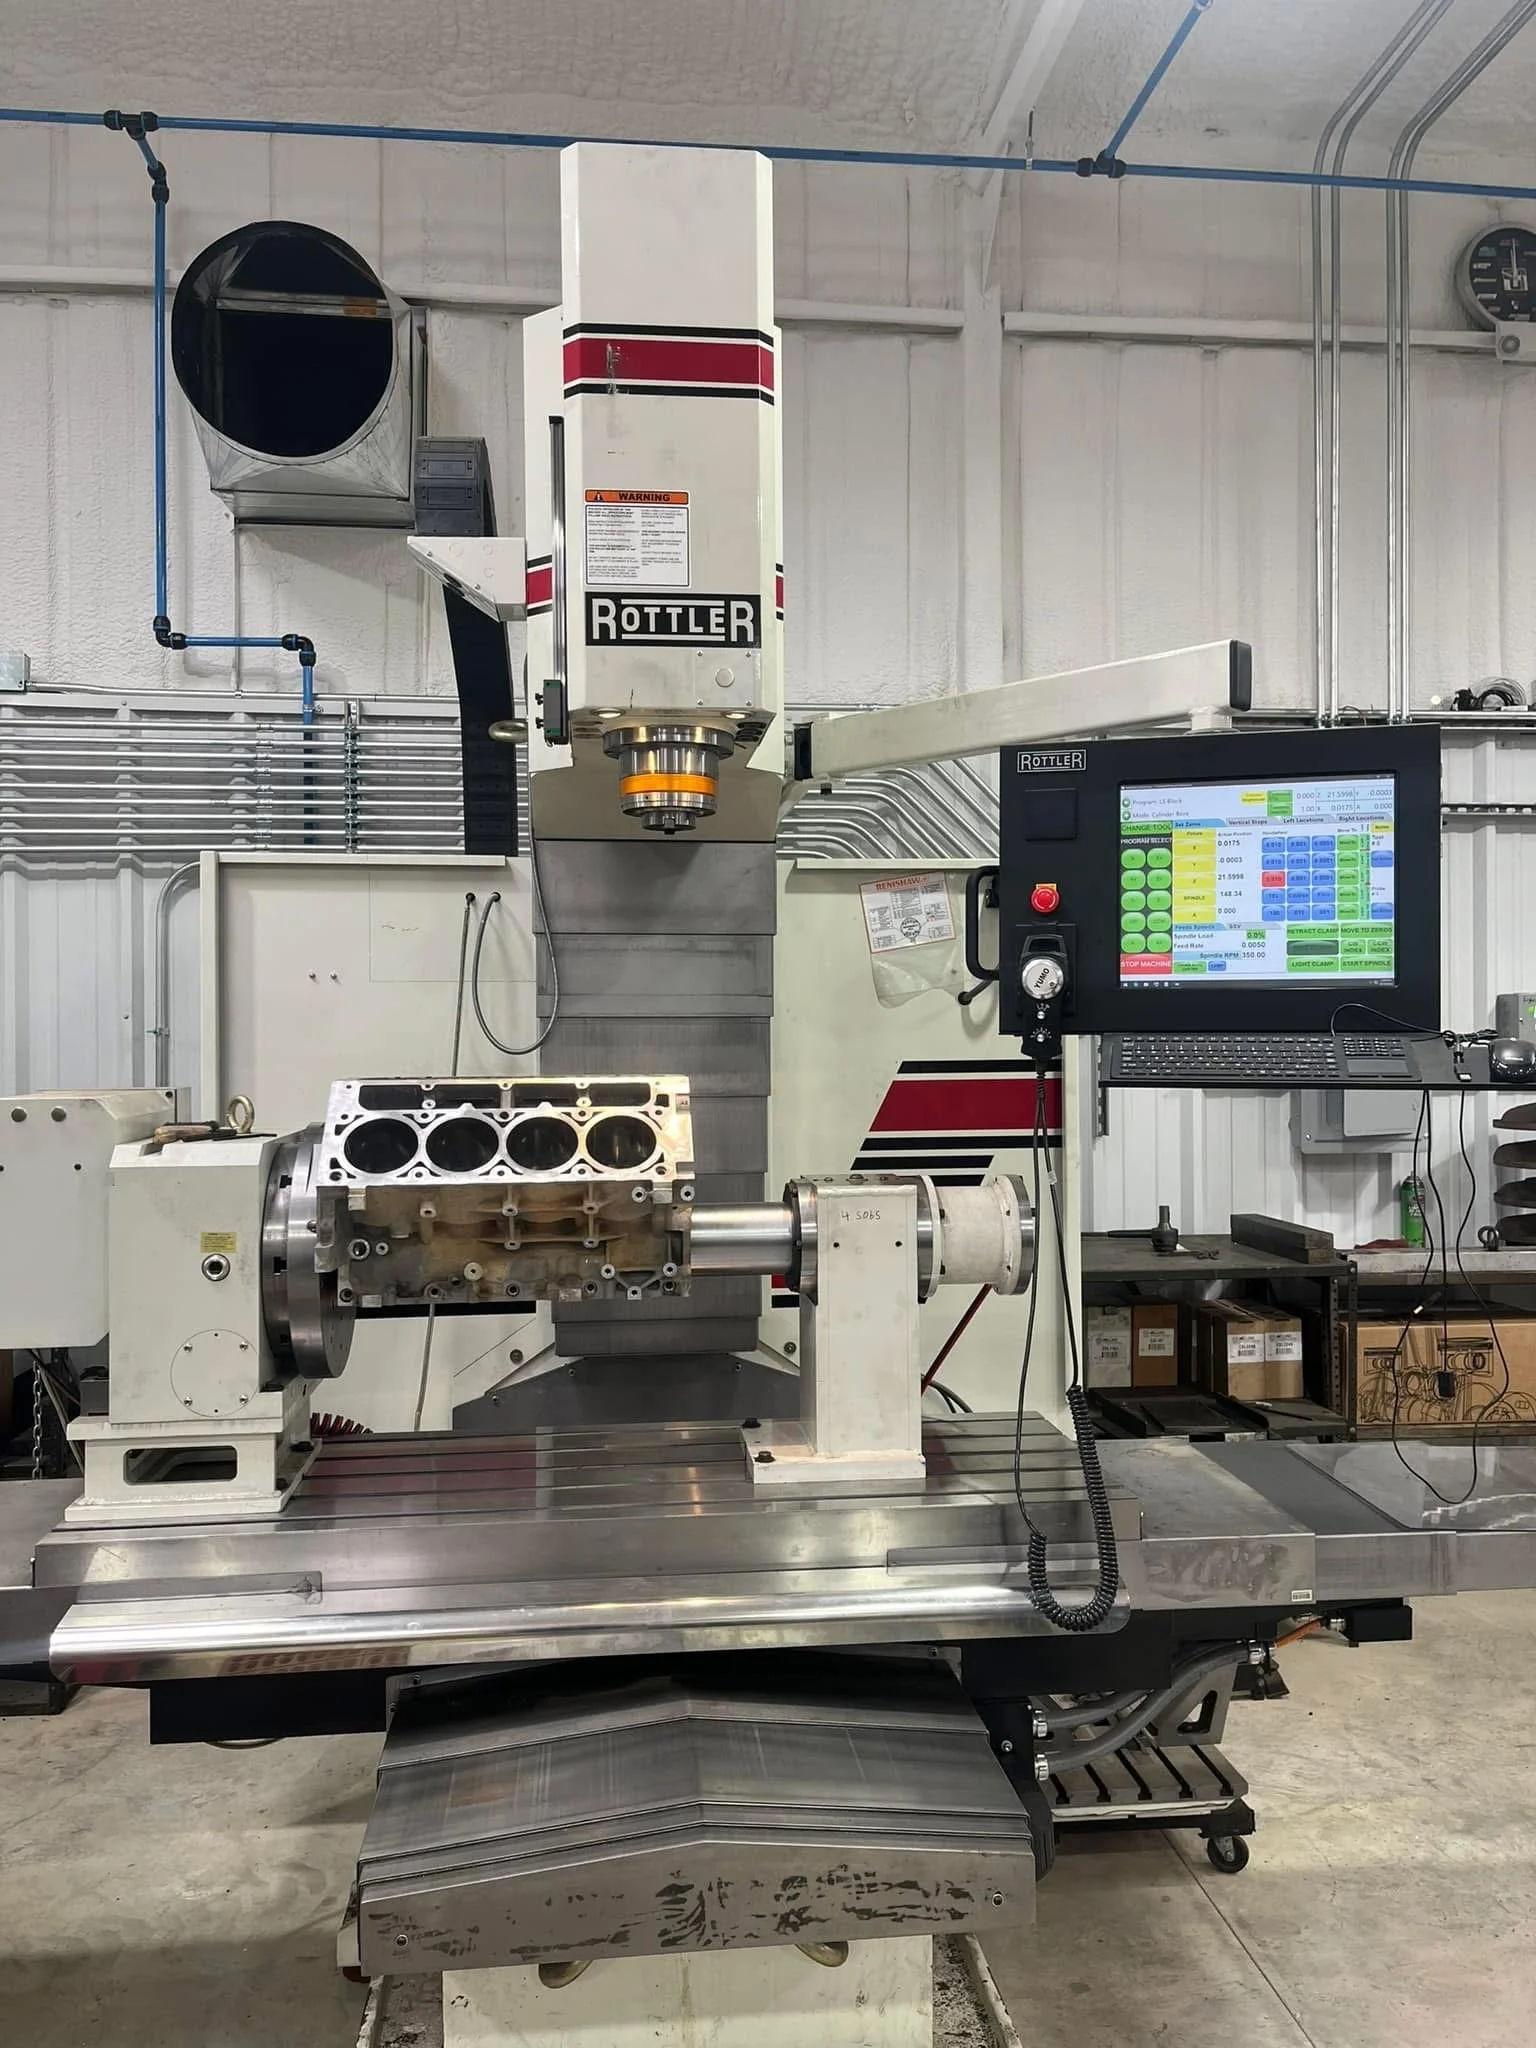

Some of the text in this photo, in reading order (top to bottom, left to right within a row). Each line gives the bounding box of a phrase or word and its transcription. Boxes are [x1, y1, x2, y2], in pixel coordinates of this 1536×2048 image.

[619, 493, 671, 502] WARNING
[591, 598, 755, 642] ROTTLER
[1021, 752, 1082, 770] ROTTLER
[1120, 824, 1149, 832] CHANGE
[1199, 952, 1222, 960] Spindle
[1034, 967, 1050, 990] YUMO
